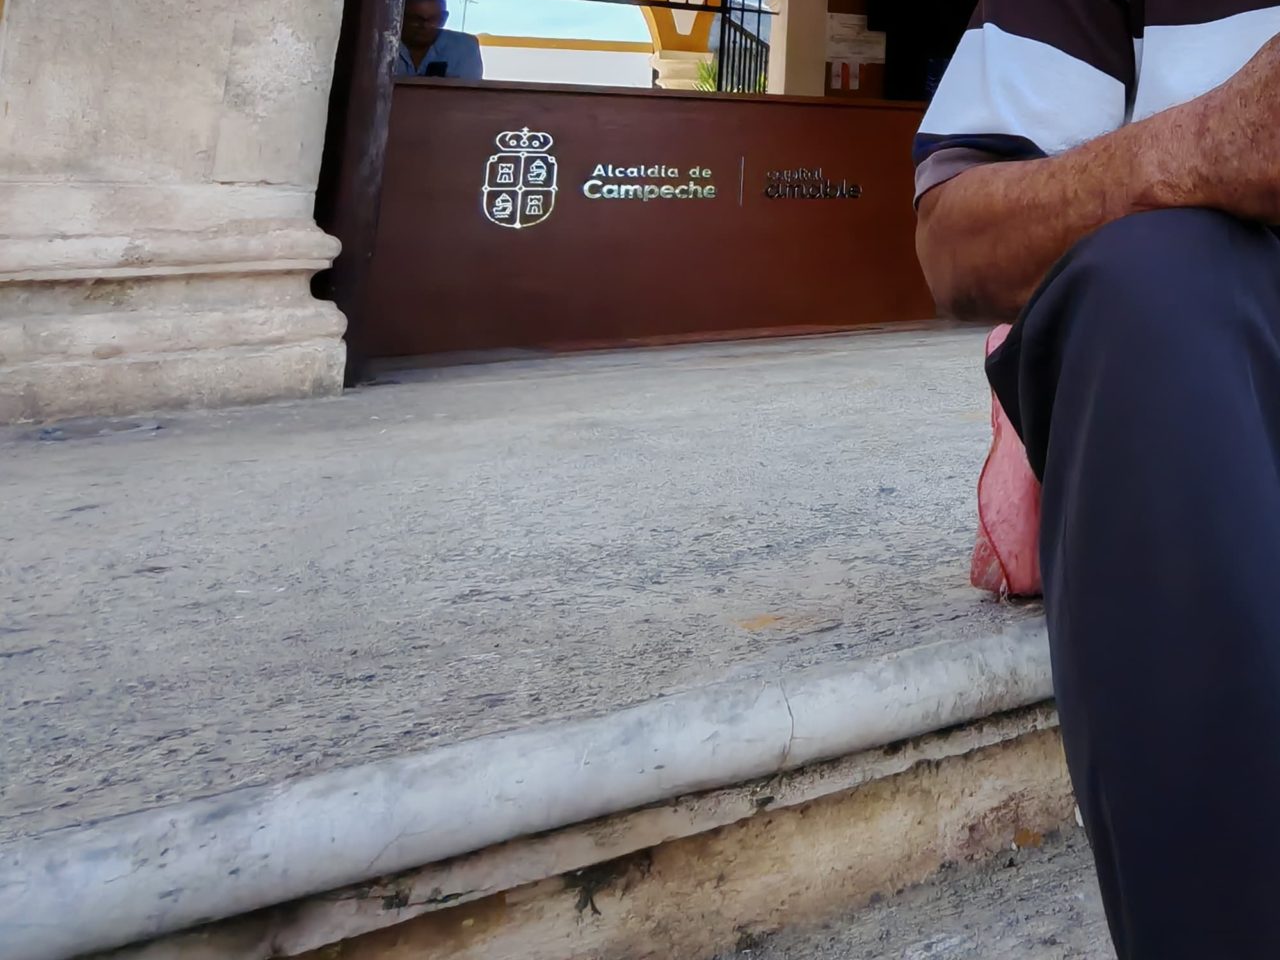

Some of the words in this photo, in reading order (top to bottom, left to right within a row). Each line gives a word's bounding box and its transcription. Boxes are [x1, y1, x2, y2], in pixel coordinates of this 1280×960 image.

[592, 164, 679, 178] Alcaldía
[689, 166, 712, 178] de
[583, 179, 716, 202] Campeche
